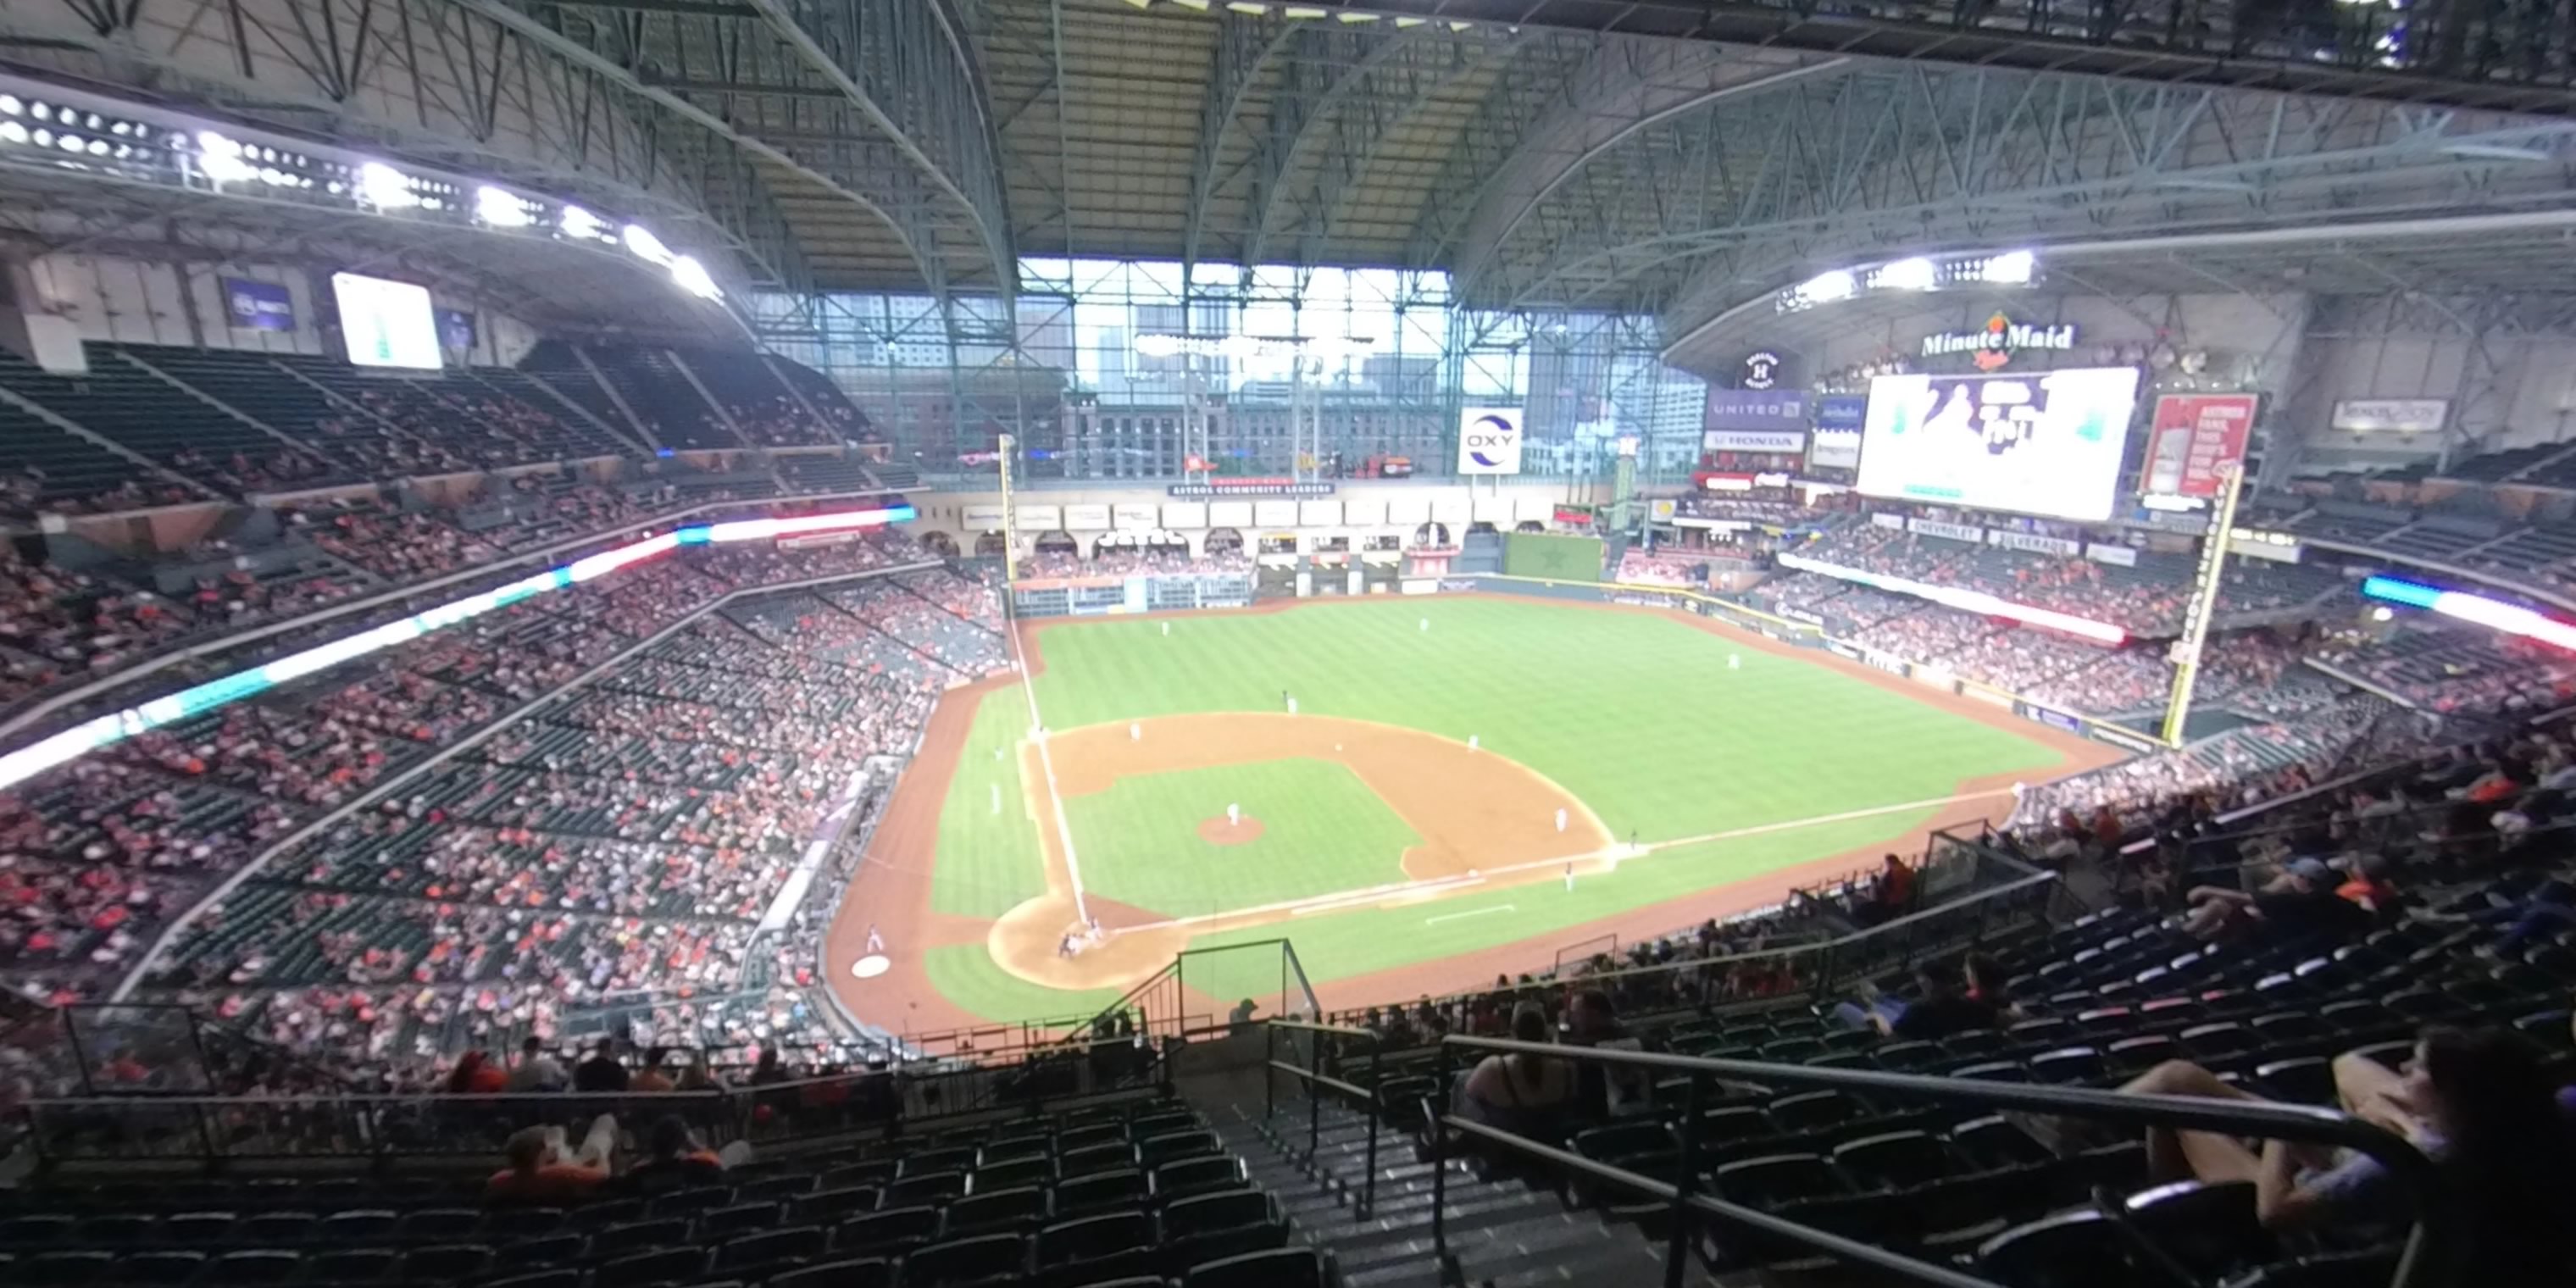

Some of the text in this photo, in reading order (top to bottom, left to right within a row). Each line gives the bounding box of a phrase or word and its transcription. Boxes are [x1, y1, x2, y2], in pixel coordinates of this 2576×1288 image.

[1921, 324, 2074, 357] Minute Maid
[1753, 364, 1769, 379] H
[1713, 404, 1779, 415] UNITED
[1467, 435, 1513, 447] OXY
[1729, 435, 1792, 446] HONDA
[1216, 486, 1282, 494] COMMUNITY
[1285, 485, 1331, 493] LEADERS
[1914, 519, 1974, 540] CHEVROLET
[1999, 533, 2068, 552] SILVERADO
